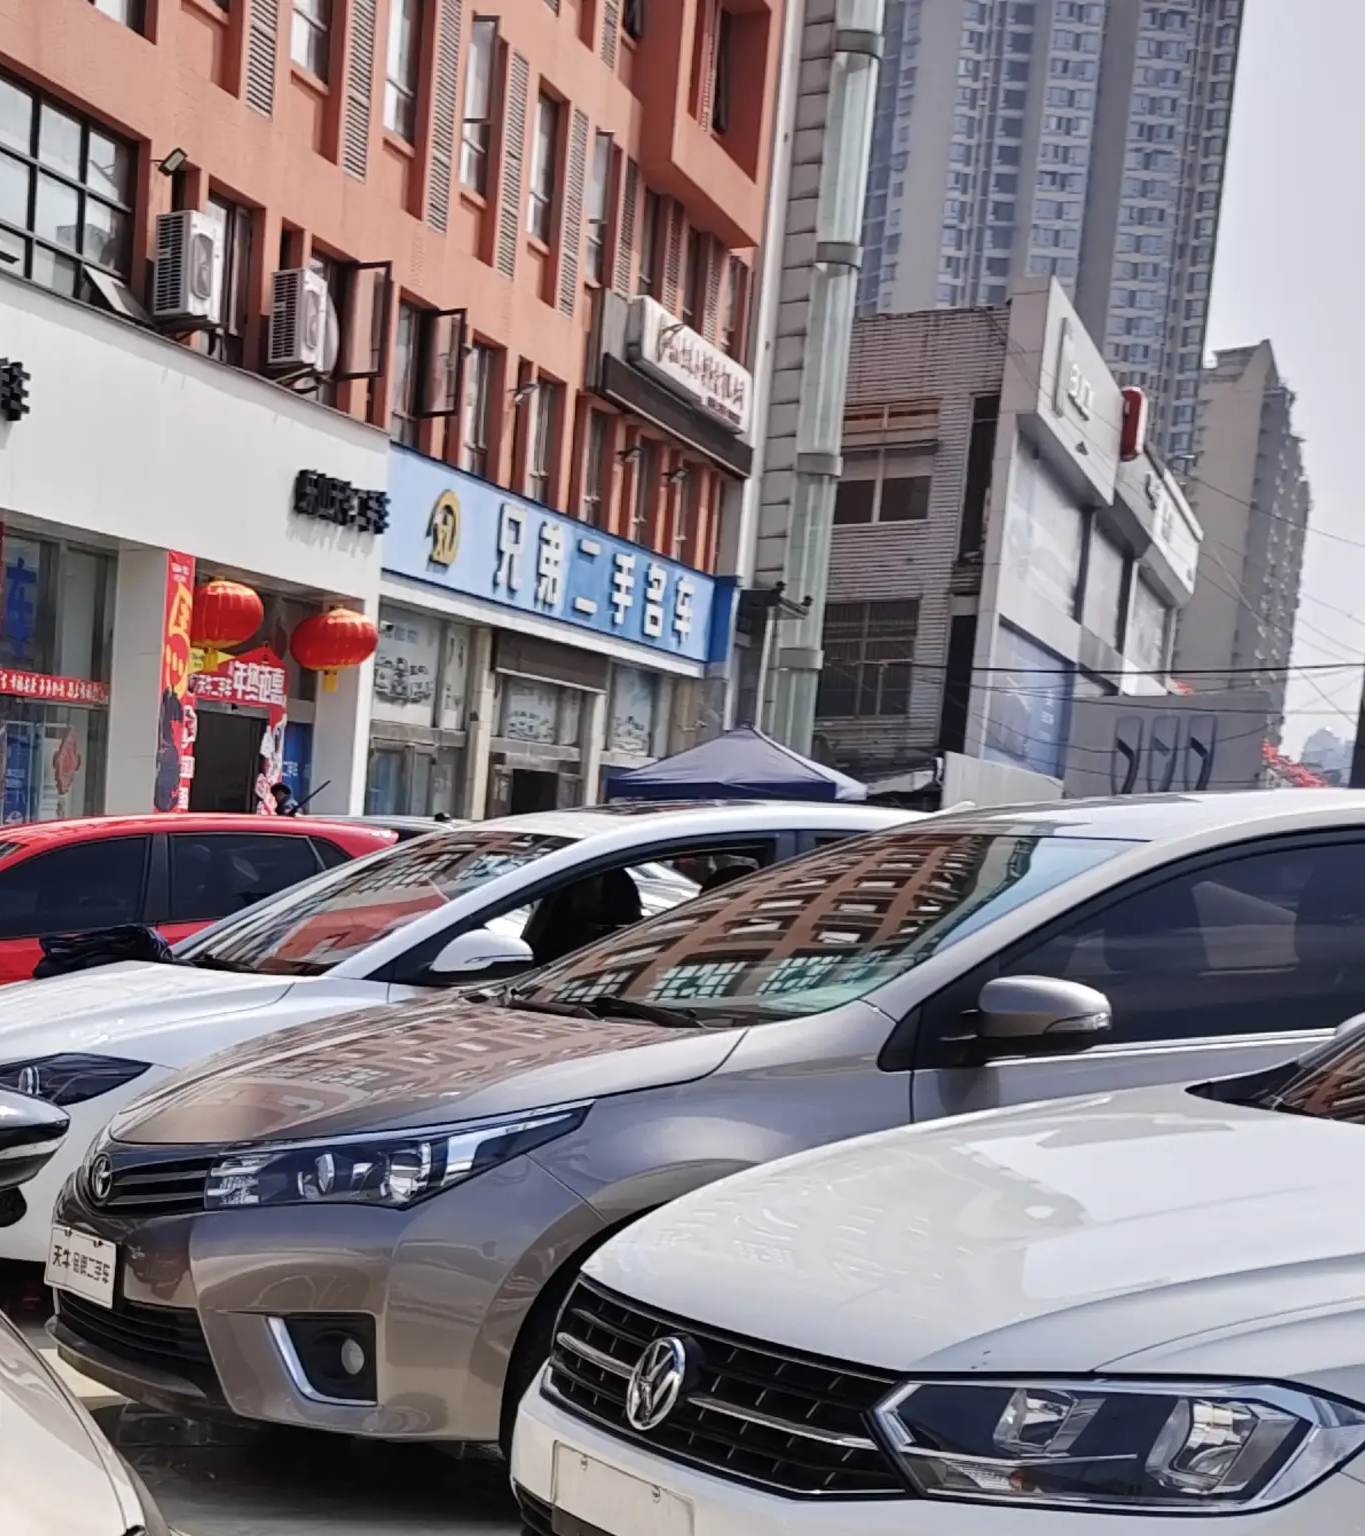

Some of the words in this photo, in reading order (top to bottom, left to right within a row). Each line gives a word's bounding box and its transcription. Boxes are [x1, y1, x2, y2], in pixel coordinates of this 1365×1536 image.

[495, 502, 696, 646] 兄弟二手名车
